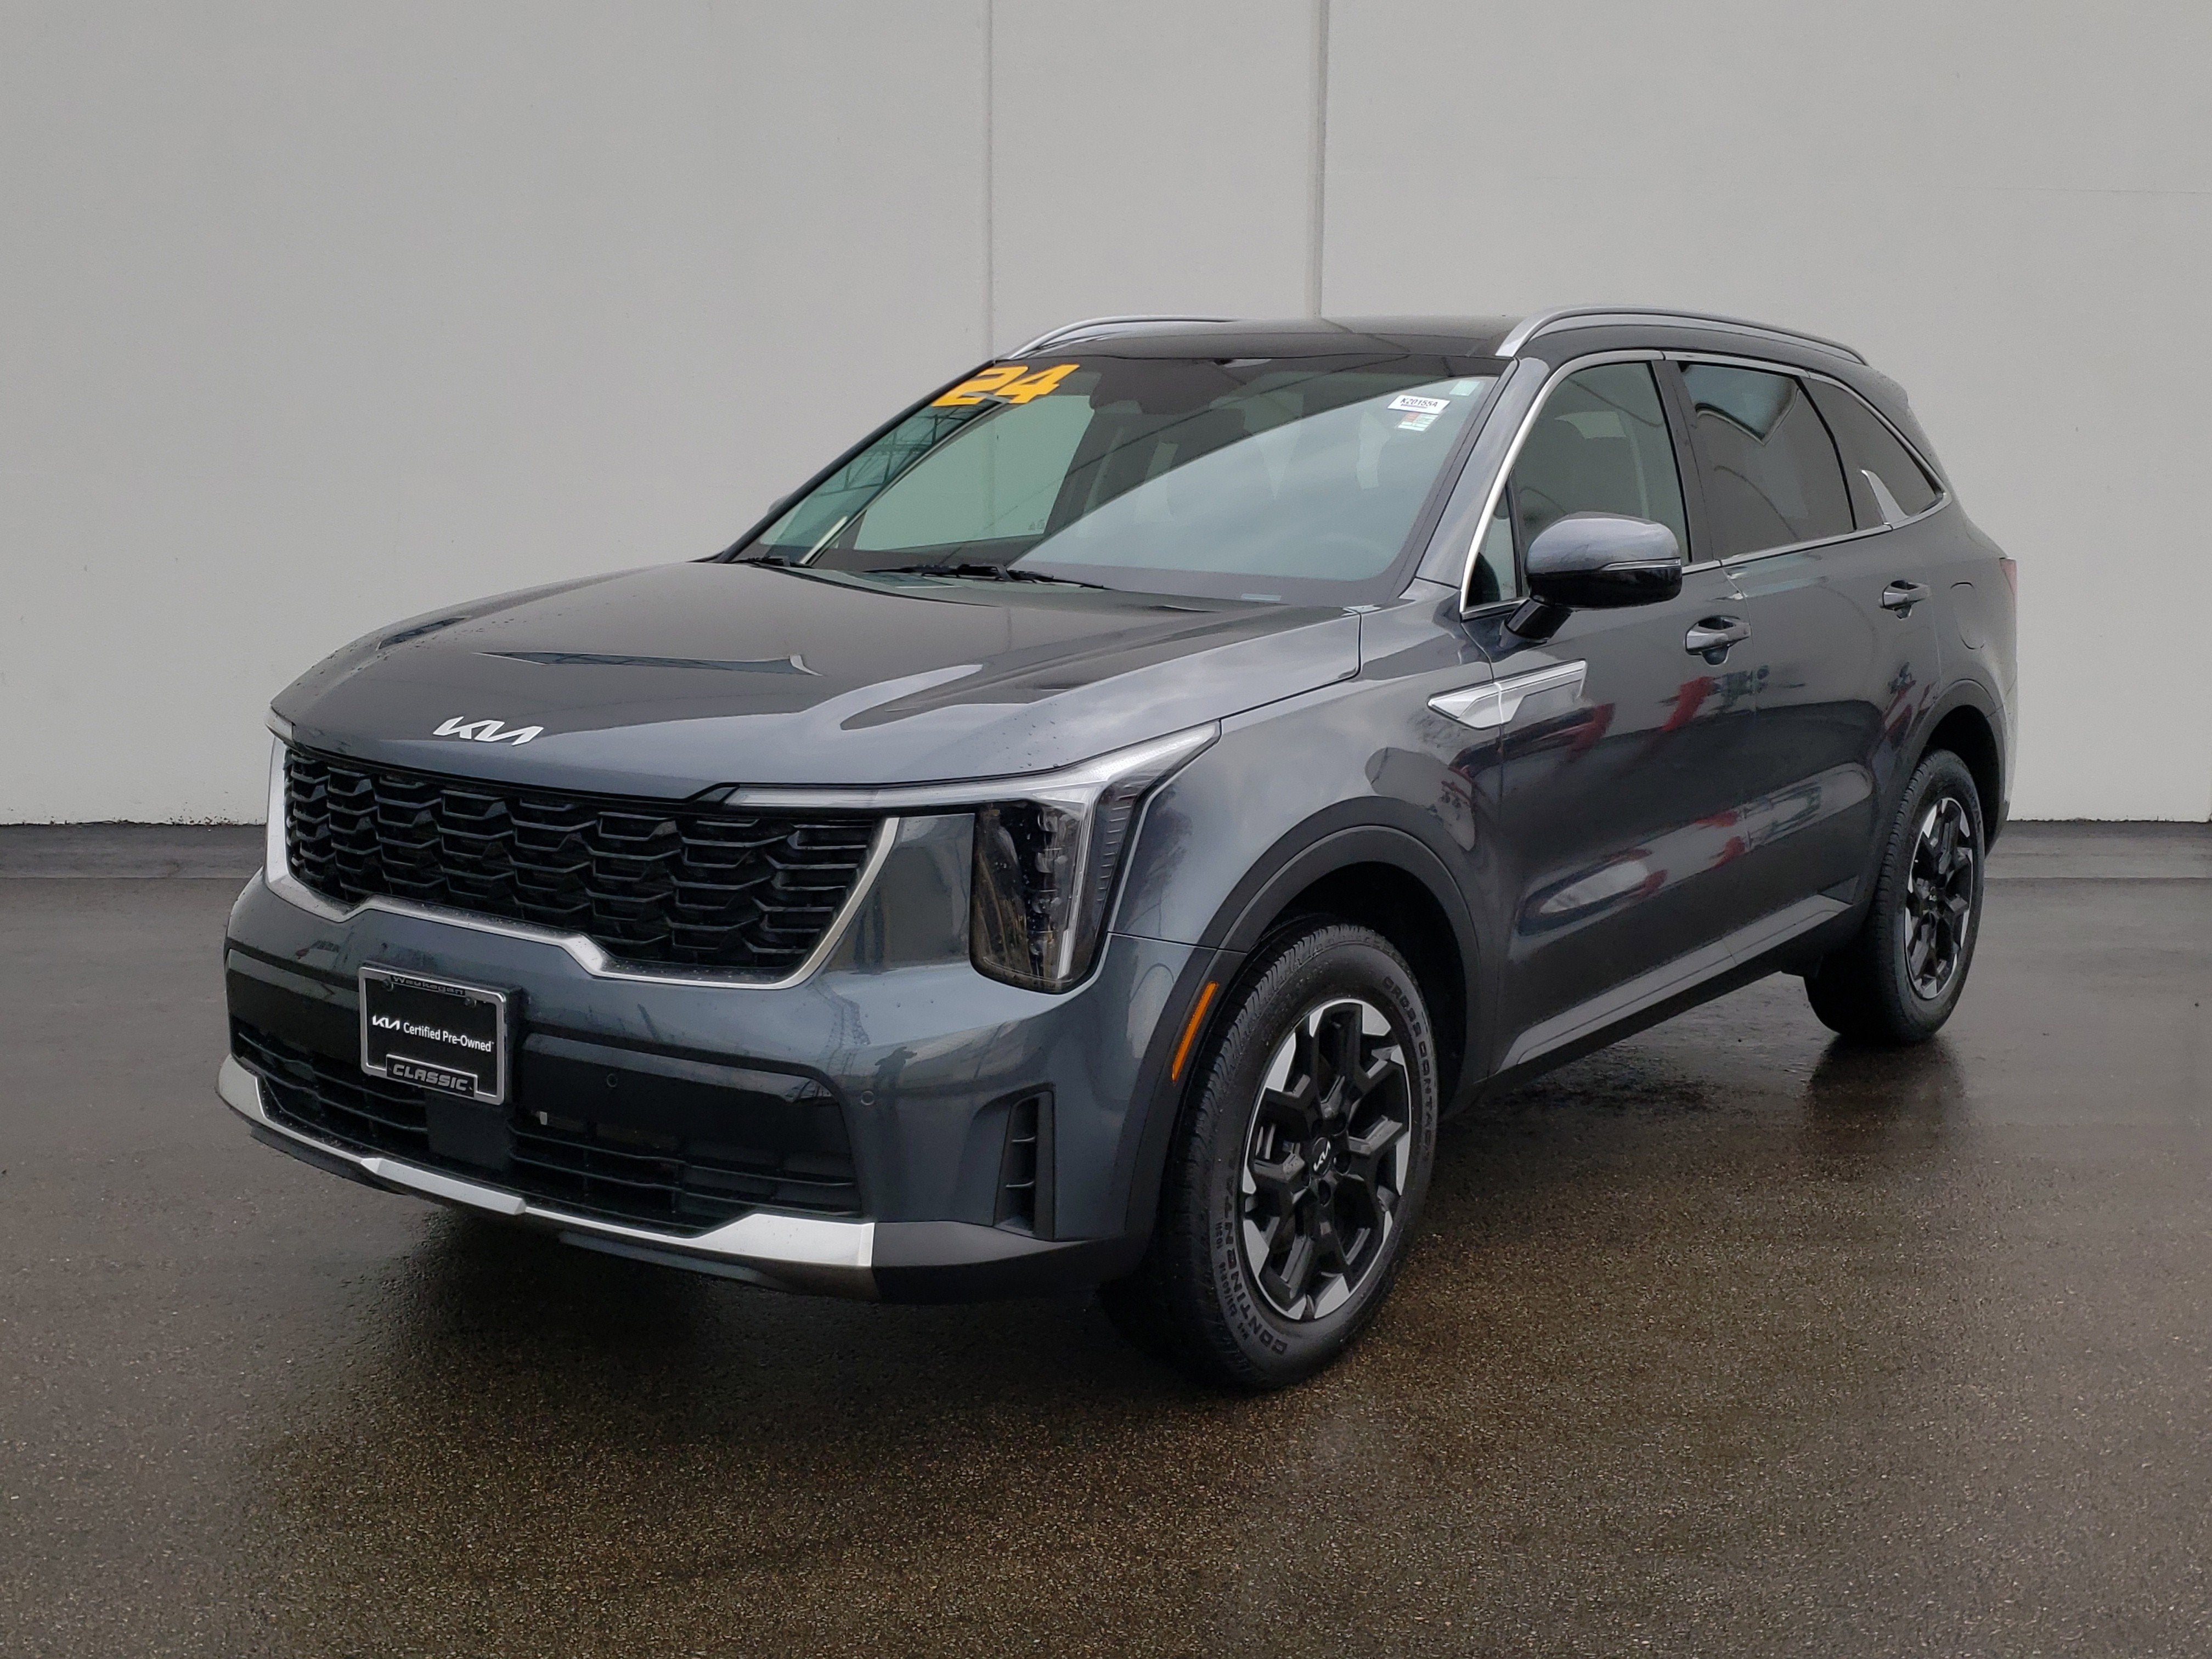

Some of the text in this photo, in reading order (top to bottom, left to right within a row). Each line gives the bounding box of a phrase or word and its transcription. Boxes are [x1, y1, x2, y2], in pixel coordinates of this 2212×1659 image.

[931, 363, 1080, 407] 24
[432, 716, 544, 746] KIA
[373, 1015, 492, 1052] KIA Certified Pre-Owned
[393, 1064, 468, 1091] CLASSIC
